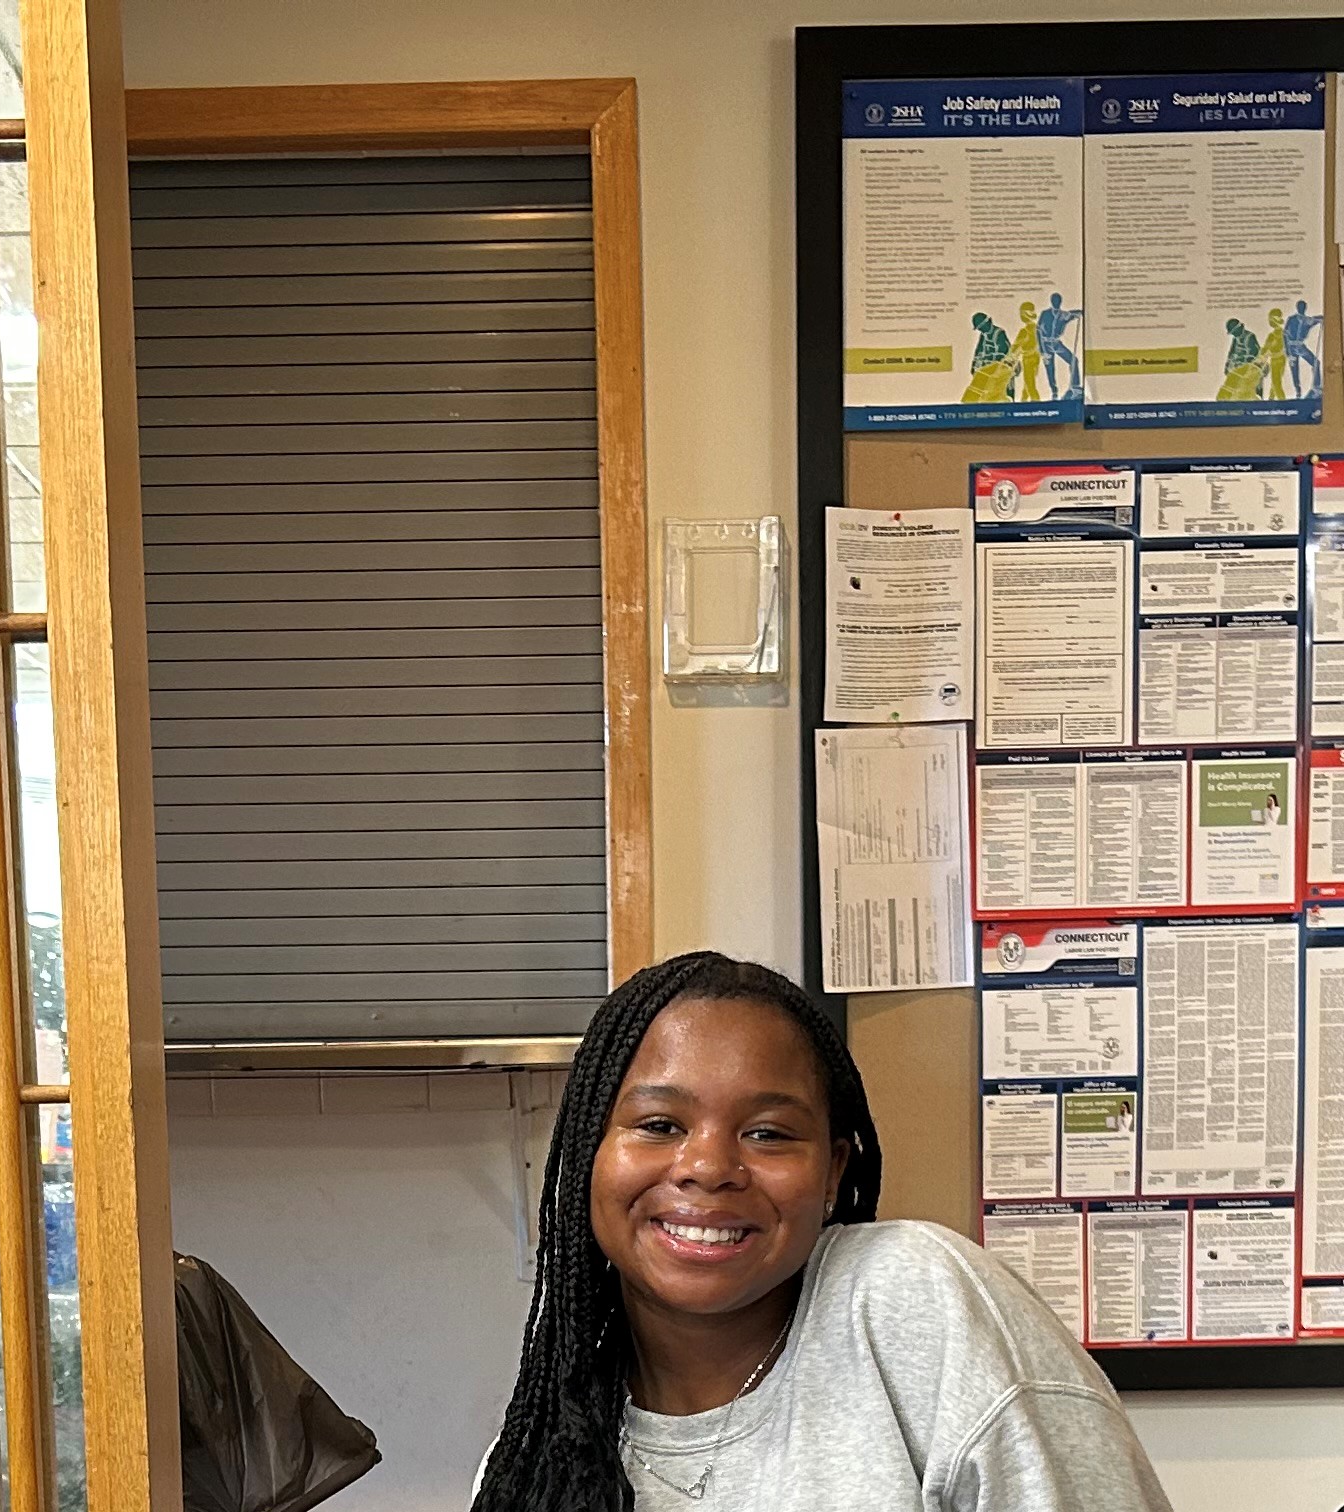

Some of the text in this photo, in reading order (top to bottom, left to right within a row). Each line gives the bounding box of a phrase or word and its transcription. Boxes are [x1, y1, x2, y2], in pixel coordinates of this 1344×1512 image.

[943, 95, 1060, 112] Job Safety and Health
[1173, 93, 1219, 107] Seguridad
[1228, 92, 1253, 105] Salud
[1255, 95, 1267, 104] en
[1278, 90, 1311, 105] Trabajo
[944, 113, 1060, 126] IT'S THE LAW!
[1228, 108, 1247, 120] LA
[1252, 107, 1285, 119] LEY!
[1050, 479, 1127, 491] CONNECTICUT
[1207, 771, 1281, 780] Health Insurance
[1216, 781, 1275, 792] Complicated.
[1055, 932, 1130, 943] CONNECTICUT
